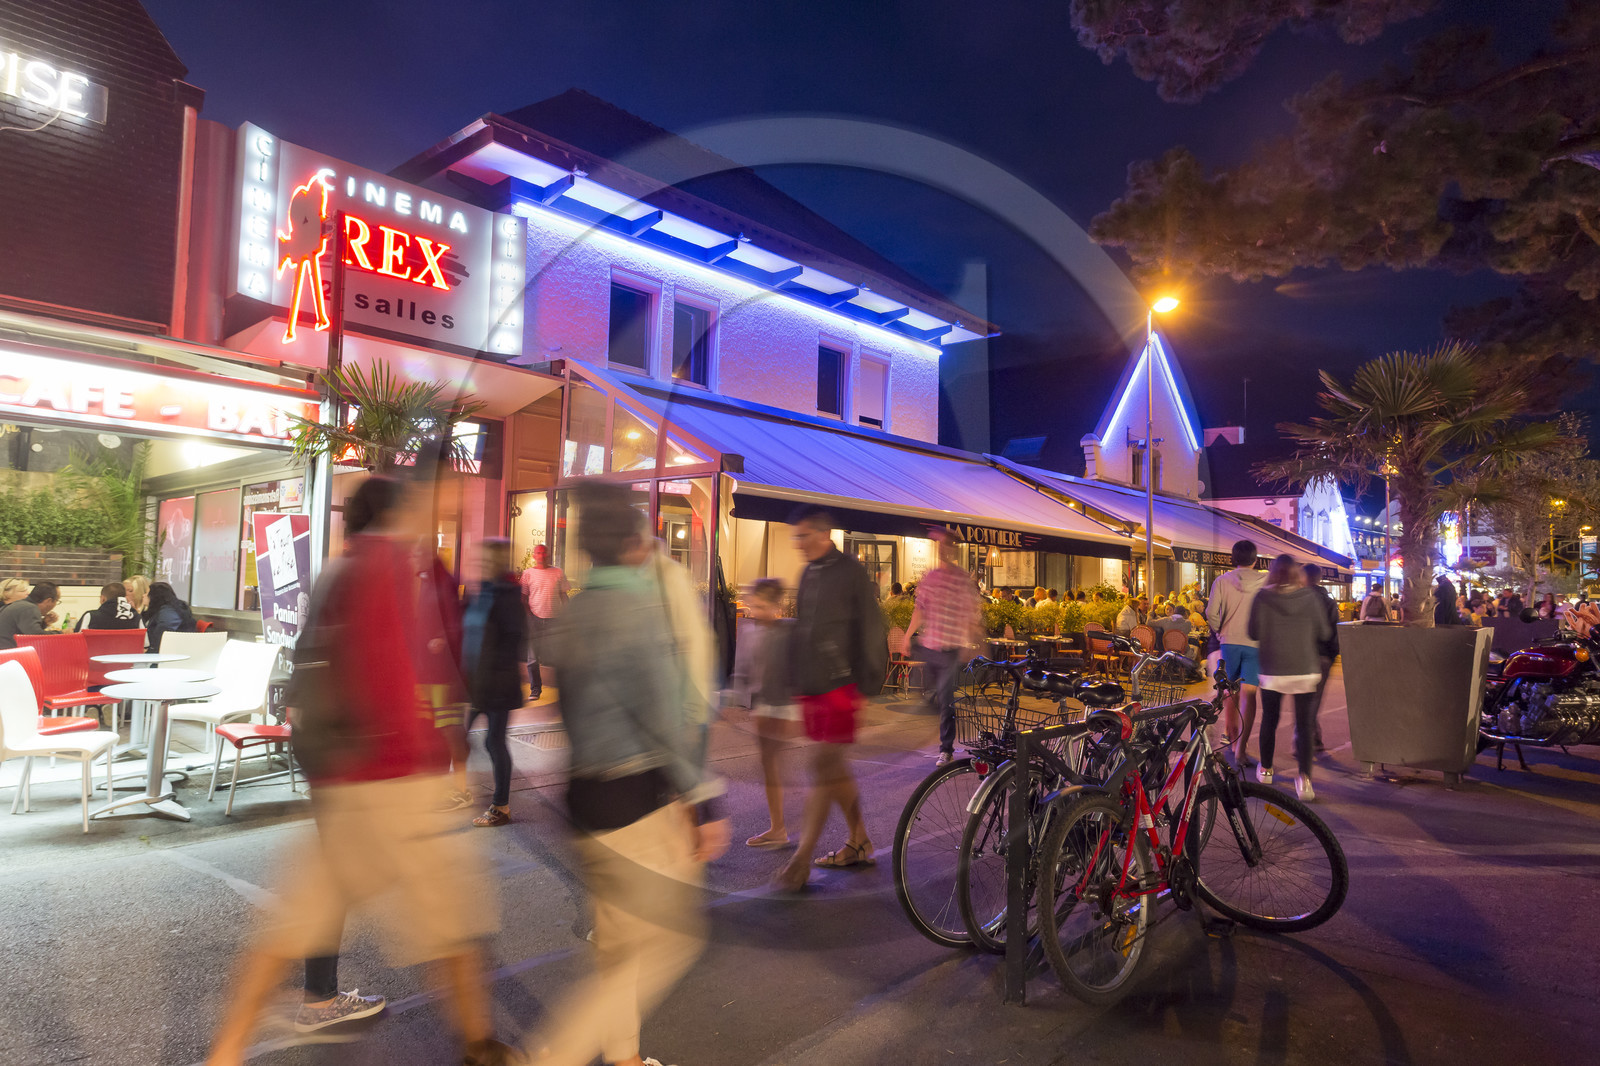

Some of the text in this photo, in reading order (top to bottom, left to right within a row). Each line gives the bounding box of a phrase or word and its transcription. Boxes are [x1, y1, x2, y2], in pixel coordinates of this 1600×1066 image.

[248, 135, 273, 295] CINEMA
[317, 168, 468, 233] CINEMA
[342, 214, 451, 290] REX
[354, 291, 455, 329] salles
[207, 397, 302, 438] BAR
[1202, 552, 1232, 565] BRASSERIE
[273, 602, 298, 626] Panini
[278, 652, 295, 674] Pizz
